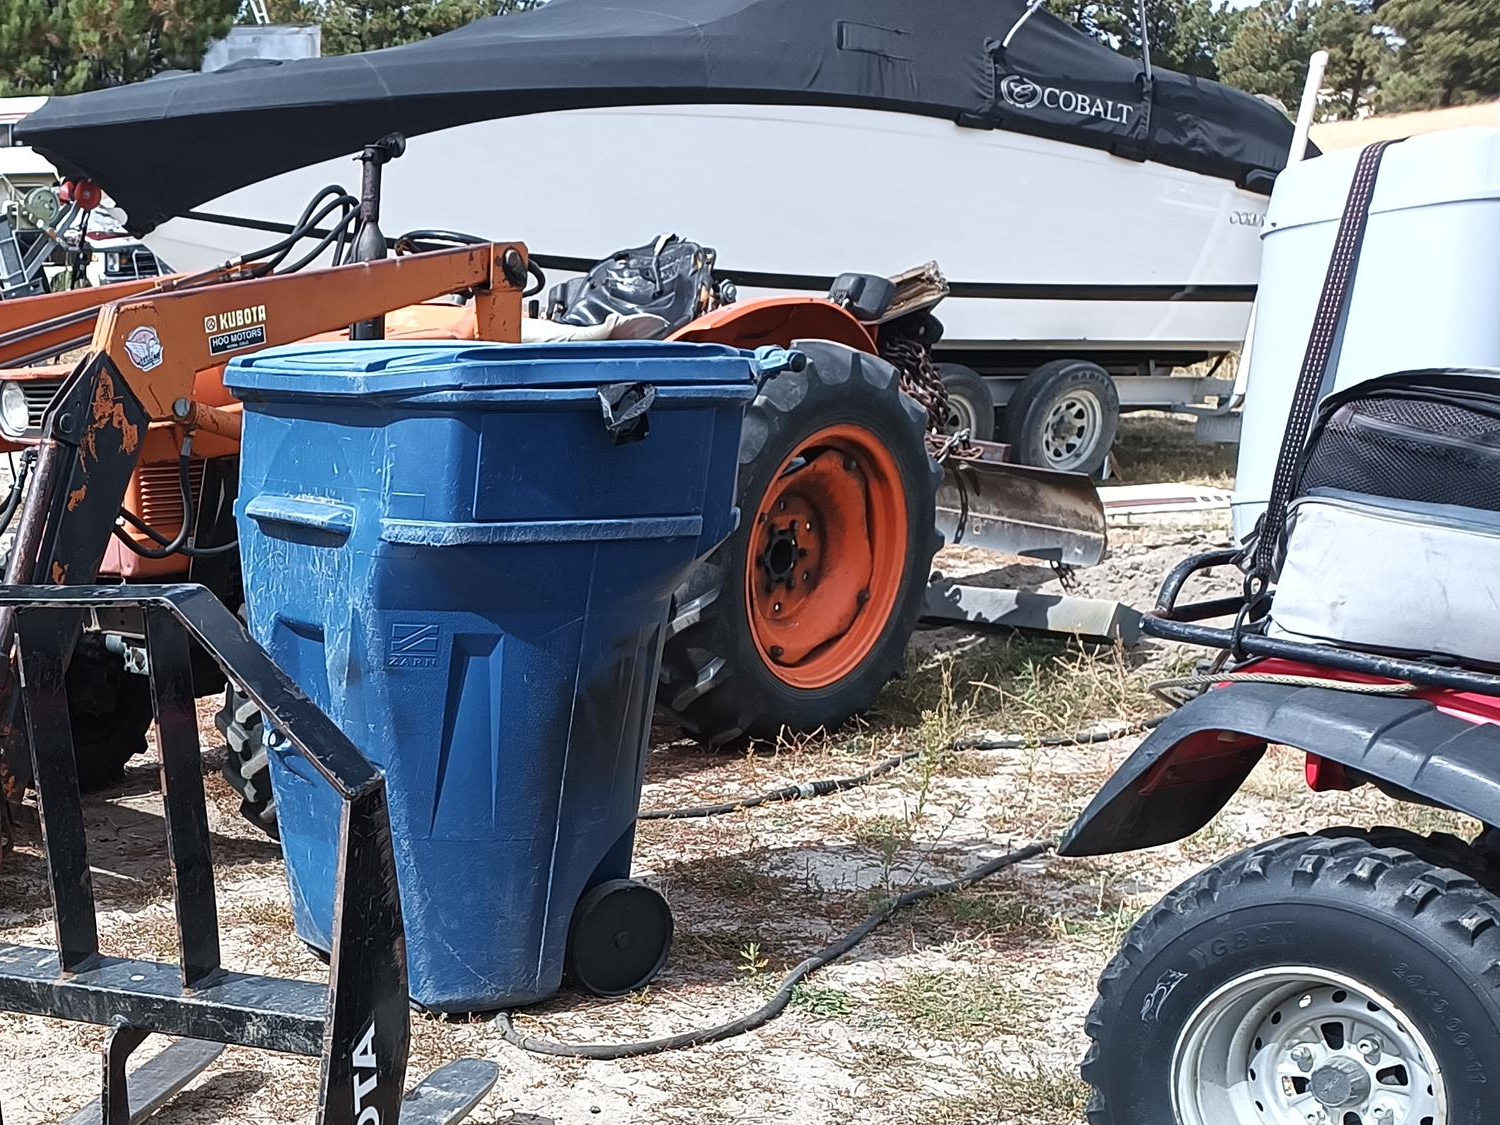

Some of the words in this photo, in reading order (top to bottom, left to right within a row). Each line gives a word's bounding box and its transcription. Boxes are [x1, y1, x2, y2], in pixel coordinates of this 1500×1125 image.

[1043, 87, 1134, 124] COBALT
[219, 304, 266, 330] KUBOTA
[212, 335, 230, 348] HOO
[230, 328, 262, 343] MOTORS
[389, 656, 437, 667] ZARN
